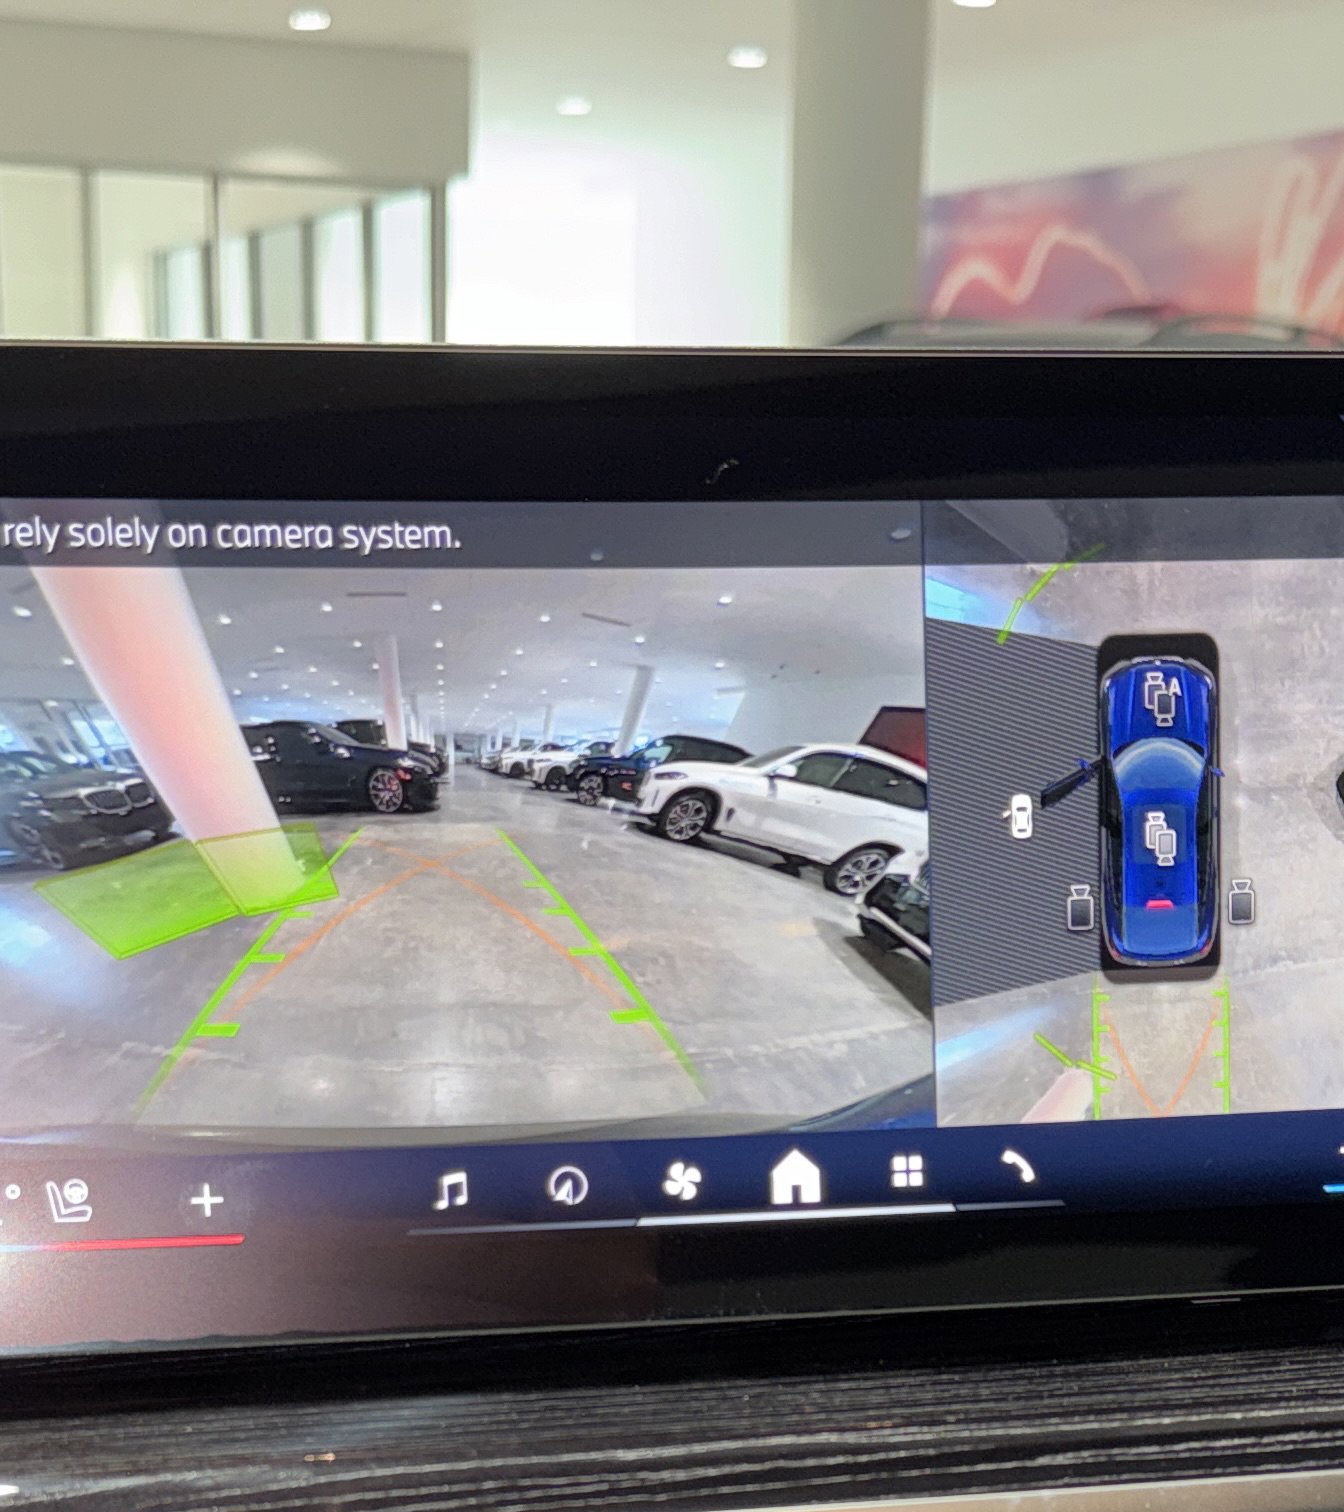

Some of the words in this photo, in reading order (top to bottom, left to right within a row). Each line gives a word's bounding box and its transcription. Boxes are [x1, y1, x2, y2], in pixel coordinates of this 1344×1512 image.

[1, 516, 58, 553] rely
[67, 515, 159, 554] solely
[167, 523, 208, 549] on
[216, 523, 334, 550] camera
[342, 521, 463, 555] system.
